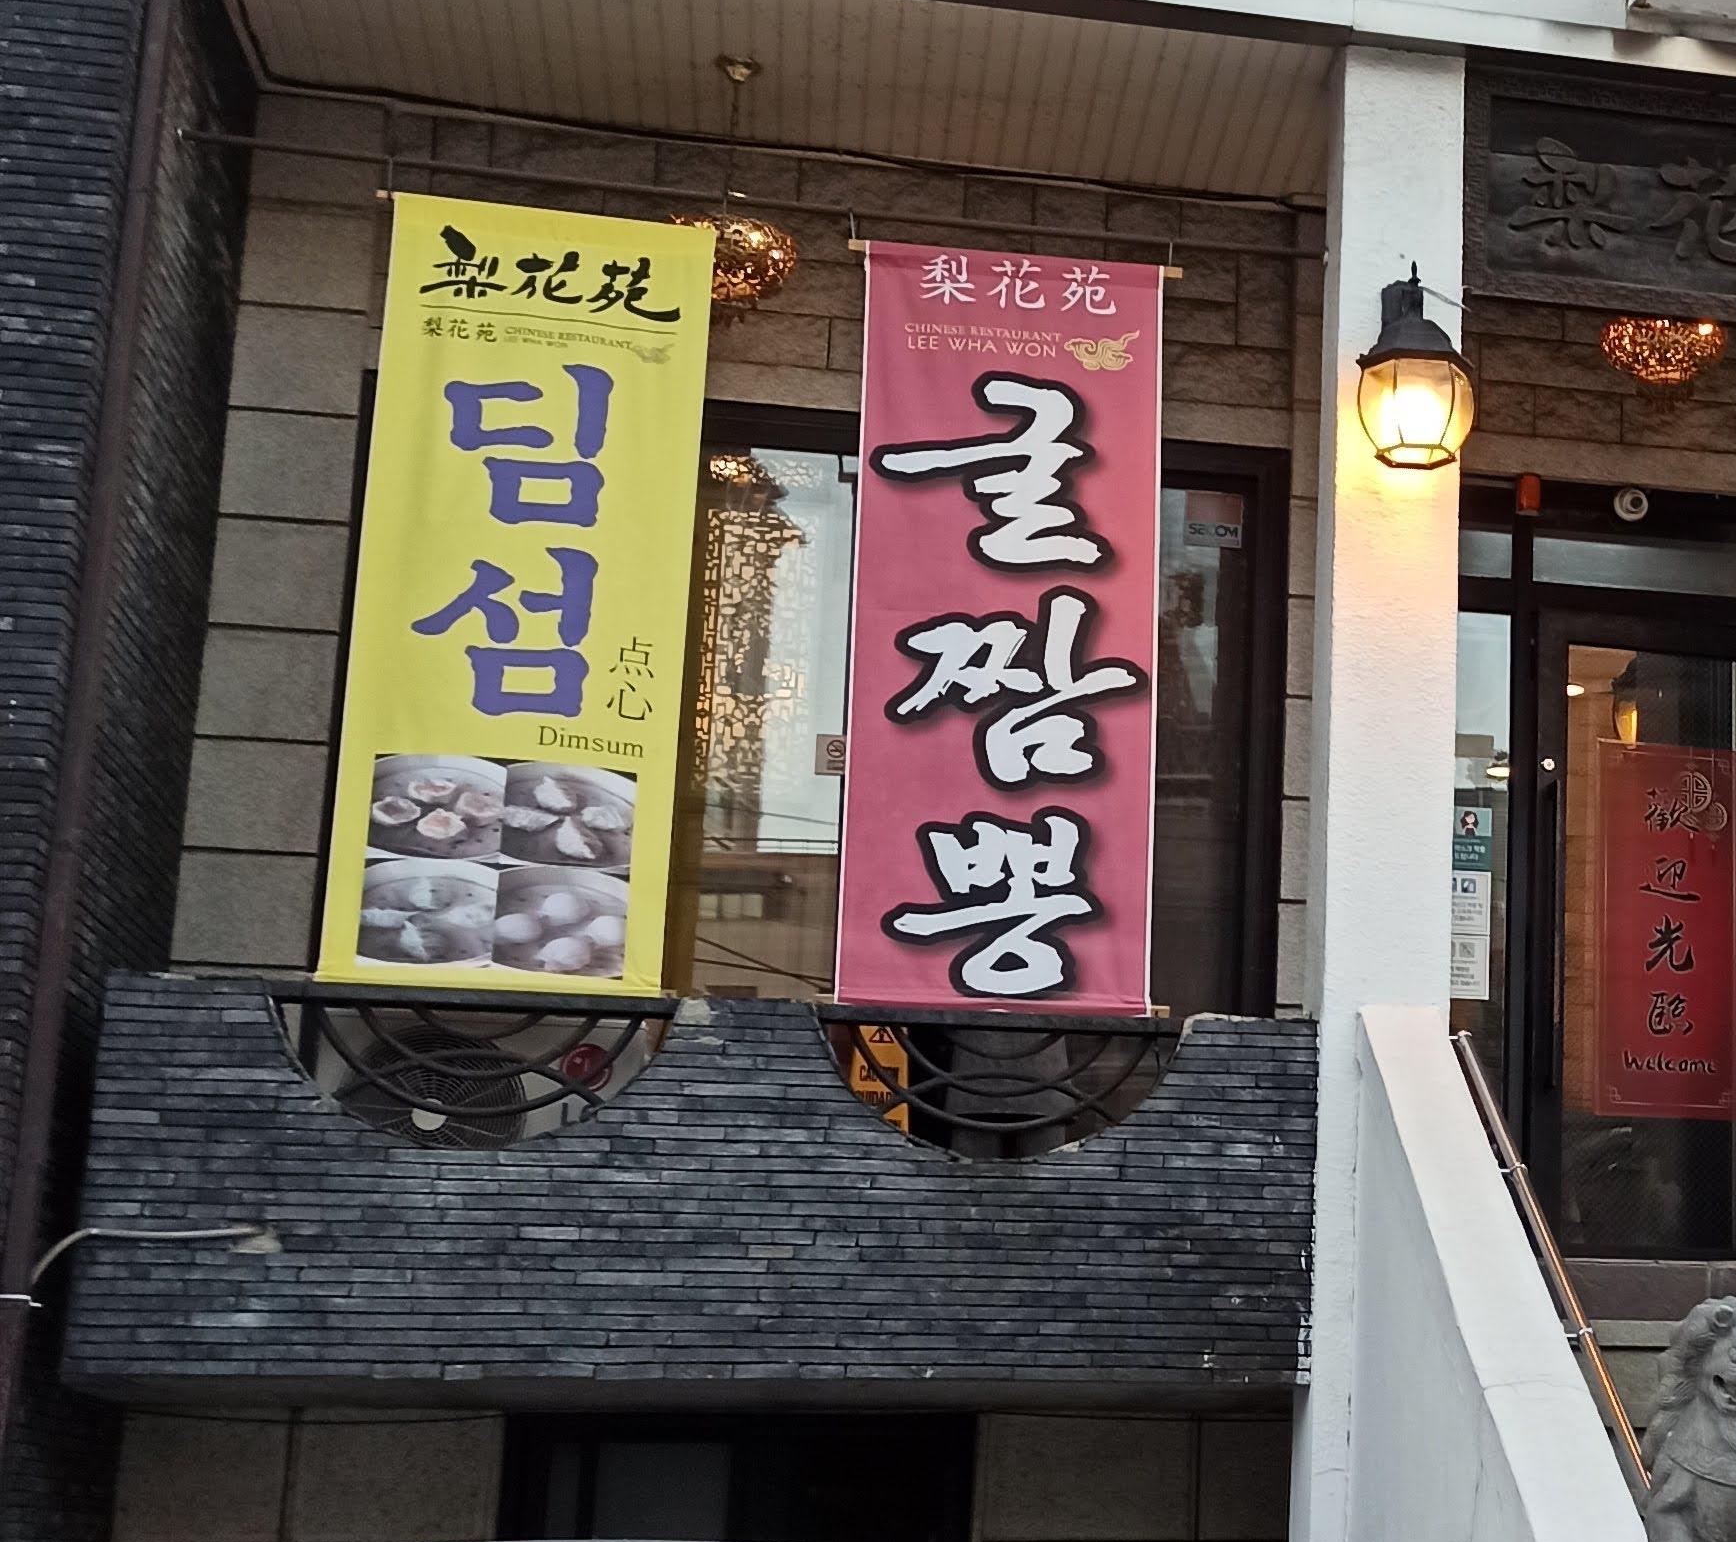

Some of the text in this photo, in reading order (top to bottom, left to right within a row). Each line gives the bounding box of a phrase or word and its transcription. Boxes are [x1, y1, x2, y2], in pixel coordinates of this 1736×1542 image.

[419, 225, 681, 322] 梨花苑
[919, 254, 1117, 315] 梨花苑
[422, 316, 497, 343] 梨花苑
[504, 326, 633, 351] CHINESE RESTAURANT
[904, 322, 1063, 343] CHINESE RESTAURANT
[907, 335, 1057, 358] LEE WHA WON
[411, 363, 614, 718] 딤섬
[606, 635, 655, 721] 点心
[876, 375, 1142, 996] 굴짬뽕
[537, 724, 645, 759] Dimsum
